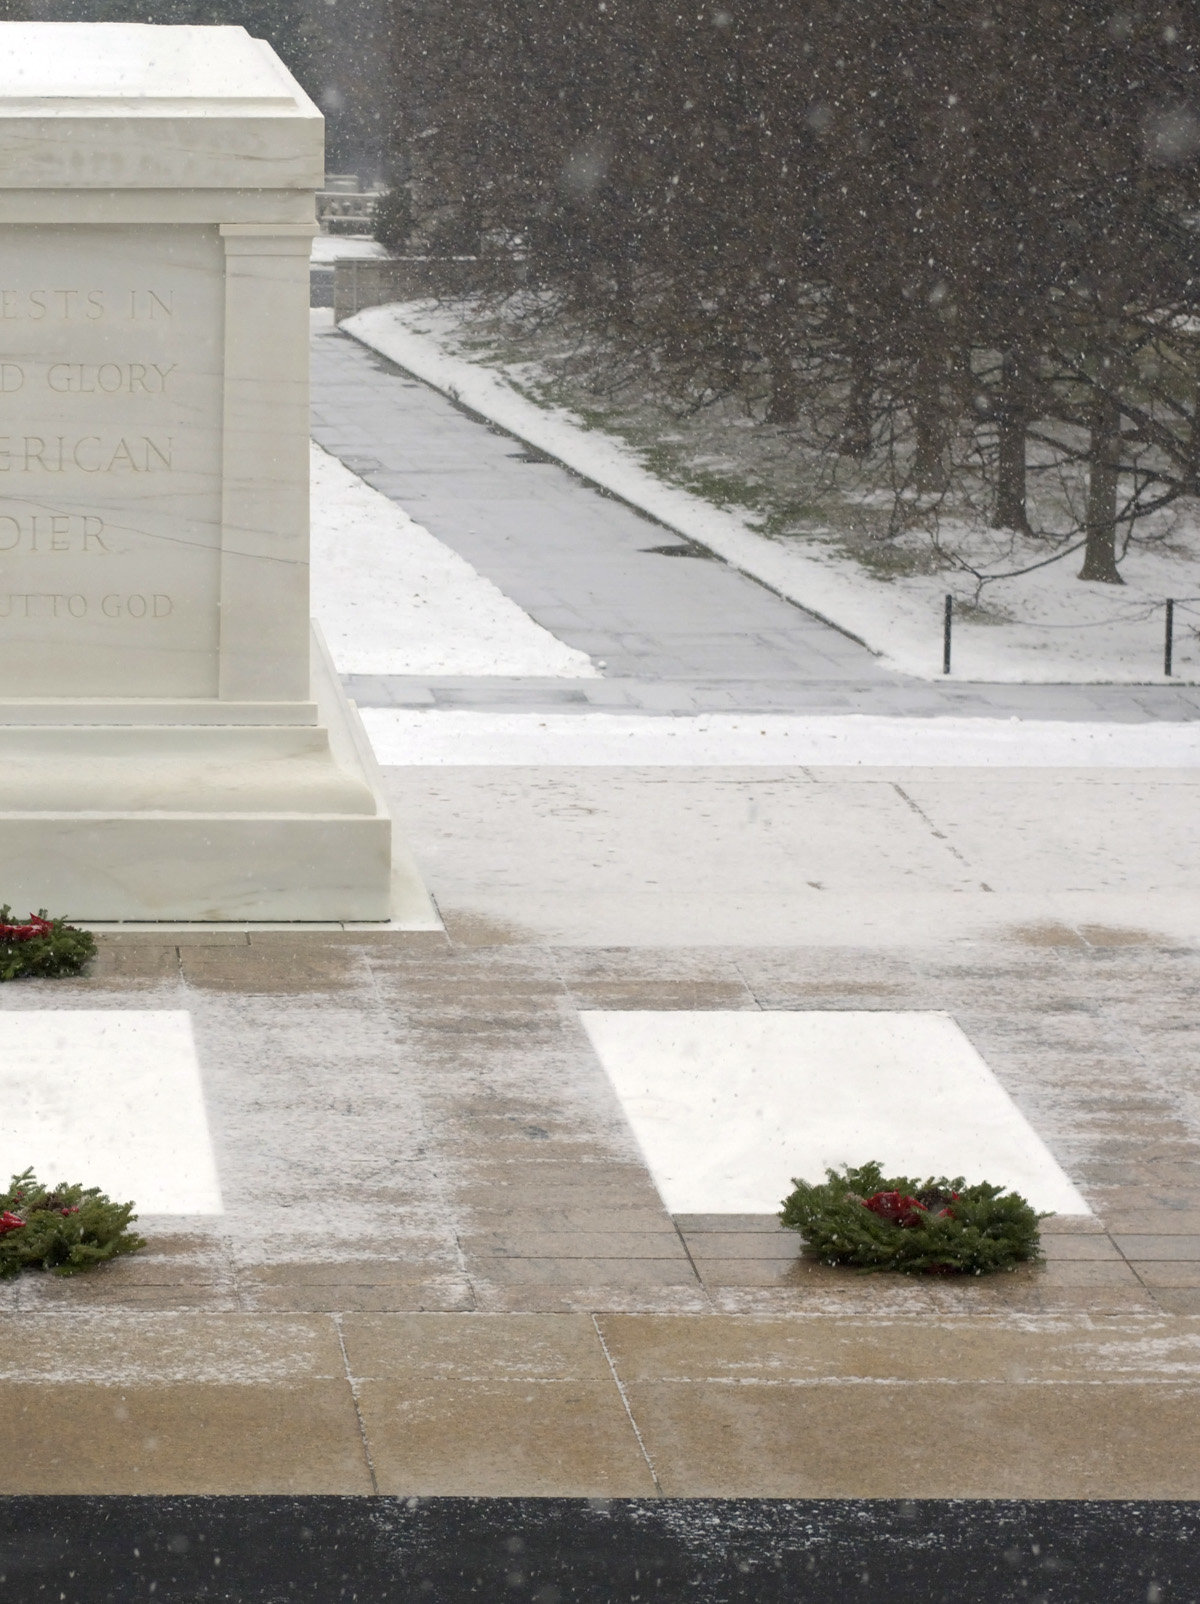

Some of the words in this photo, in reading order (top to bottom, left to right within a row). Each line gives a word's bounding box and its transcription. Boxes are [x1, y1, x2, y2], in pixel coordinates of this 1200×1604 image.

[129, 289, 174, 320] IN
[47, 362, 178, 393] GLORY
[43, 593, 87, 618] TO
[101, 593, 174, 618] GOD
